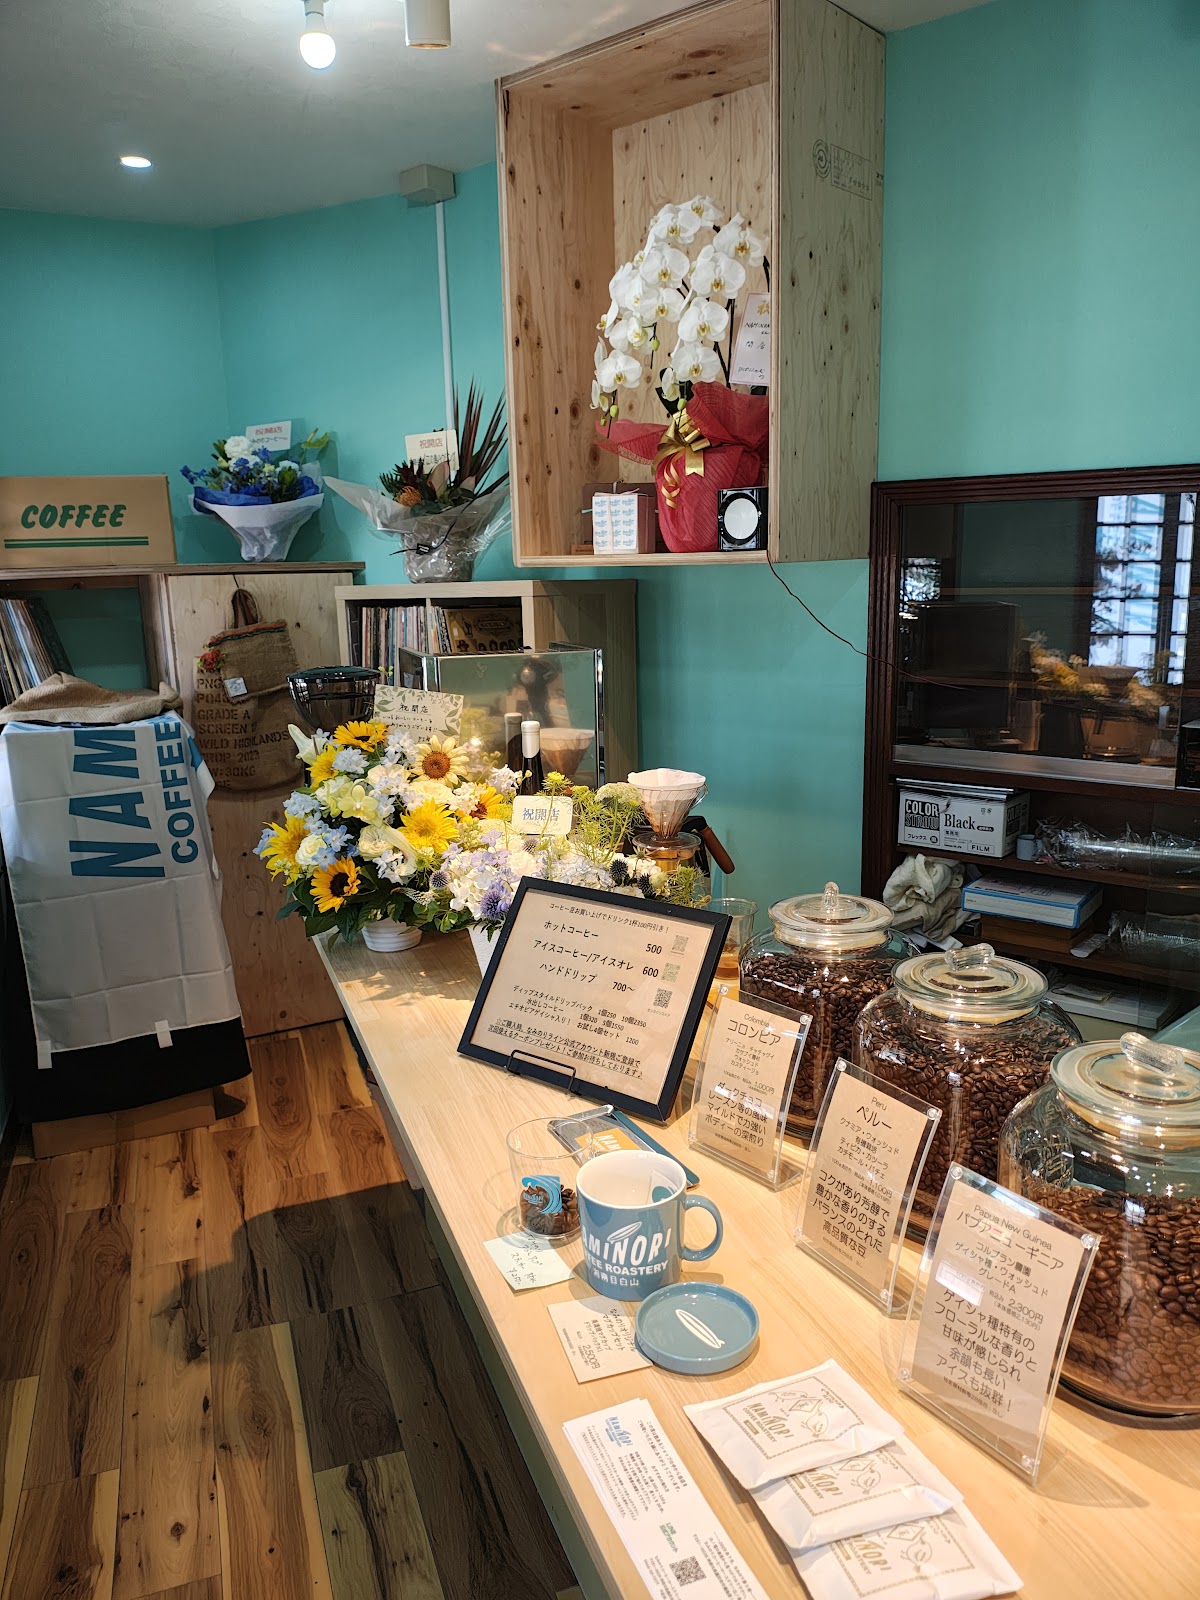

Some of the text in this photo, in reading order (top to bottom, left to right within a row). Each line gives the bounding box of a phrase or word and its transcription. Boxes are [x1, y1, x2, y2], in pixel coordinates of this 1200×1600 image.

[21, 504, 127, 529] COFFEE
[197, 709, 250, 720] GRADE A
[398, 702, 429, 714] 祝開店
[198, 723, 247, 735] SCREEN
[199, 730, 289, 749] WILD HIGHLANDS
[237, 750, 260, 763] 2023
[154, 722, 199, 864] COFFEE
[522, 806, 560, 822] 祝開店
[905, 800, 939, 817] COLOR
[905, 813, 939, 830] STRAW
[944, 813, 976, 830] Black
[971, 844, 990, 852] FILM
[543, 920, 662, 954] ホットコーヒー 500
[532, 939, 659, 977] アイスコーヒー/アイスオレ 600
[539, 962, 597, 984] ハンドドリップ
[526, 997, 564, 1013] 水出しコーヒー
[743, 1013, 769, 1028] Colombia
[625, 1036, 639, 1045] 1200
[727, 1019, 780, 1048] コロンビア
[754, 1080, 774, 1095] 1,000円
[870, 1096, 887, 1111] Peru
[705, 1112, 763, 1148] ボディーの深煎り
[707, 1101, 766, 1136] マイルドで力強い
[855, 1103, 892, 1135] ペルー
[855, 1135, 877, 1154] 有機栽培
[818, 1168, 889, 1223] コクがあり芳醇で
[868, 1178, 892, 1198] 1,100円
[814, 1182, 887, 1239] 豊かな香りのする
[812, 1196, 884, 1253] バランスのとれた
[973, 1203, 1052, 1251] Papua New Guinea
[821, 1218, 867, 1258] 高品質な豆
[957, 1210, 1063, 1274] パプアニューギニア
[605, 1260, 668, 1275] ROASTERY
[978, 1265, 1017, 1294] グレードA
[988, 1289, 1004, 1303] 税込み
[1008, 1296, 1043, 1325] 2,300円
[942, 1288, 1035, 1353] ゲイシャ種特有の
[934, 1300, 1038, 1373] フローラルな香りと
[582, 1344, 600, 1369] 2,500円
[940, 1321, 1022, 1385] 甘味が感じられ
[948, 1344, 1007, 1393] 余韻も長い
[747, 1402, 794, 1438] NAMINORI
